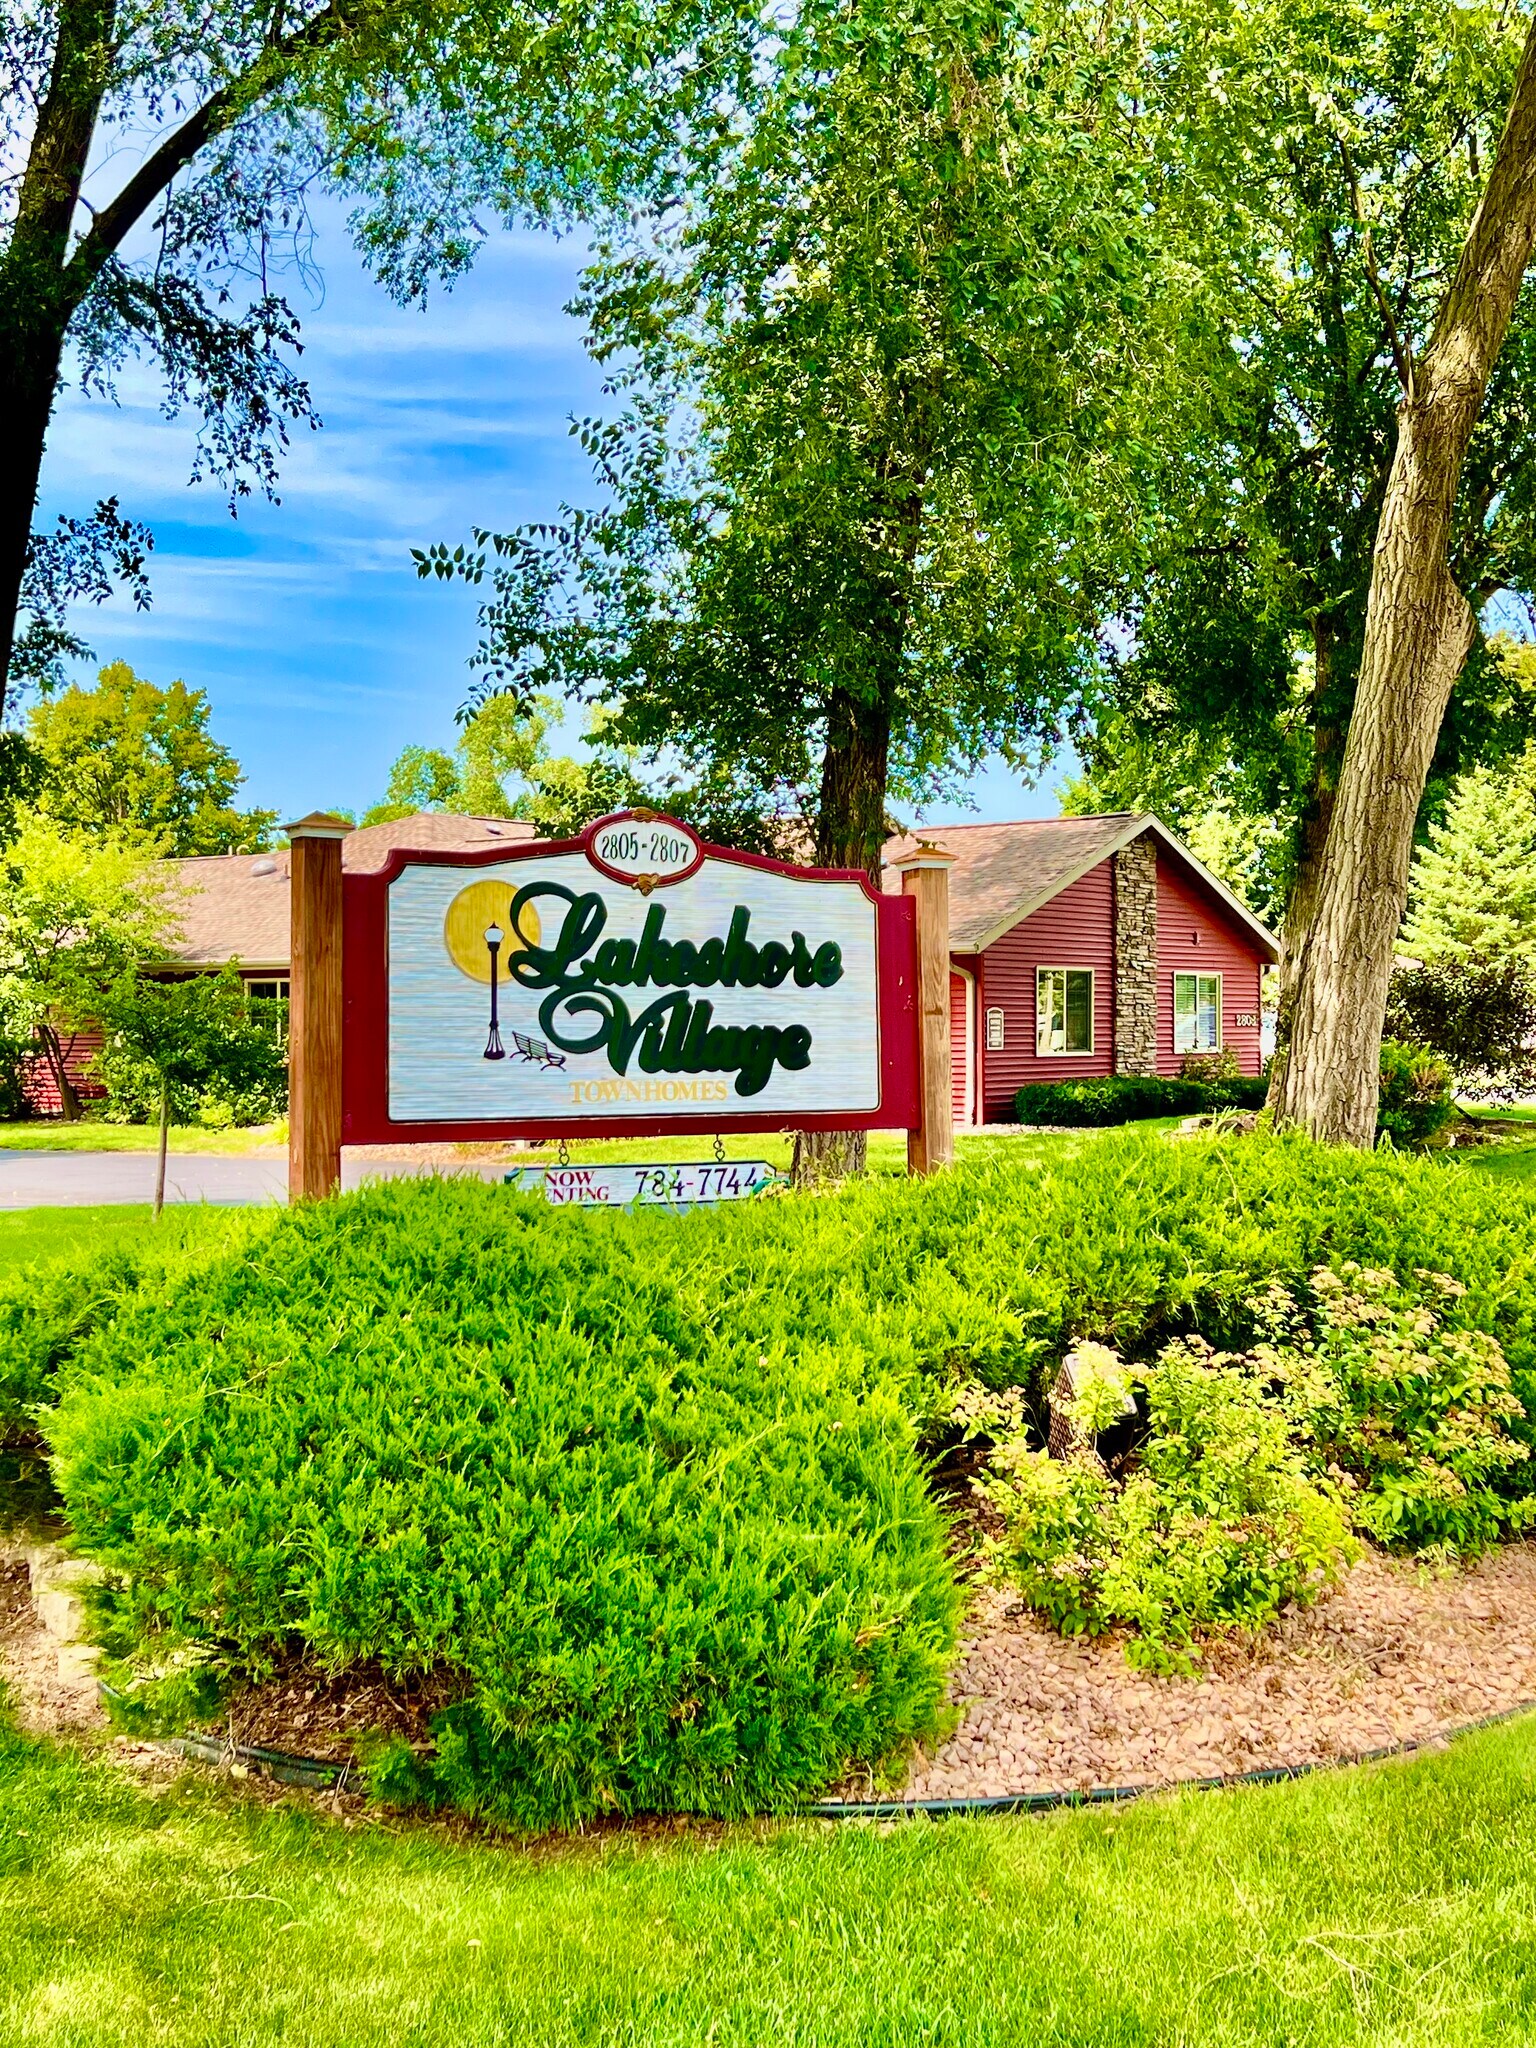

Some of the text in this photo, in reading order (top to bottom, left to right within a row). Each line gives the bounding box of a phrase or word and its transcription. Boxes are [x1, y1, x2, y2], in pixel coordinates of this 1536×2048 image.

[508, 880, 844, 989] Lakeshore
[538, 985, 812, 1097] Village
[569, 1078, 729, 1104] TOWNHOMES
[544, 1170, 595, 1187] NOW
